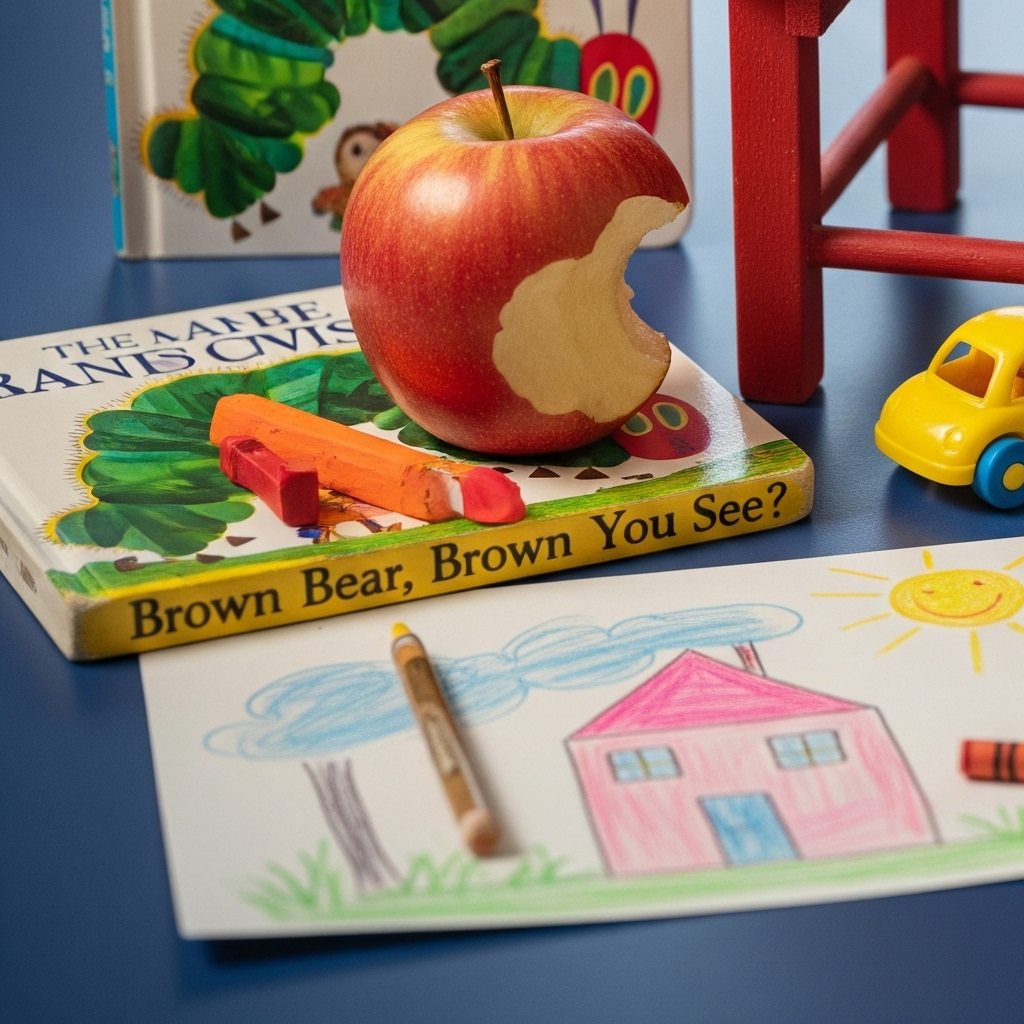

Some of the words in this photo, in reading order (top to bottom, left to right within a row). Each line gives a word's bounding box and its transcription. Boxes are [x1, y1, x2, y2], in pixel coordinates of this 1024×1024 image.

[41, 333, 140, 360] THE
[129, 587, 282, 641] Brown
[301, 563, 414, 608] Bear,
[430, 528, 573, 583] Brown
[589, 509, 678, 552] You
[692, 480, 789, 533] See?
